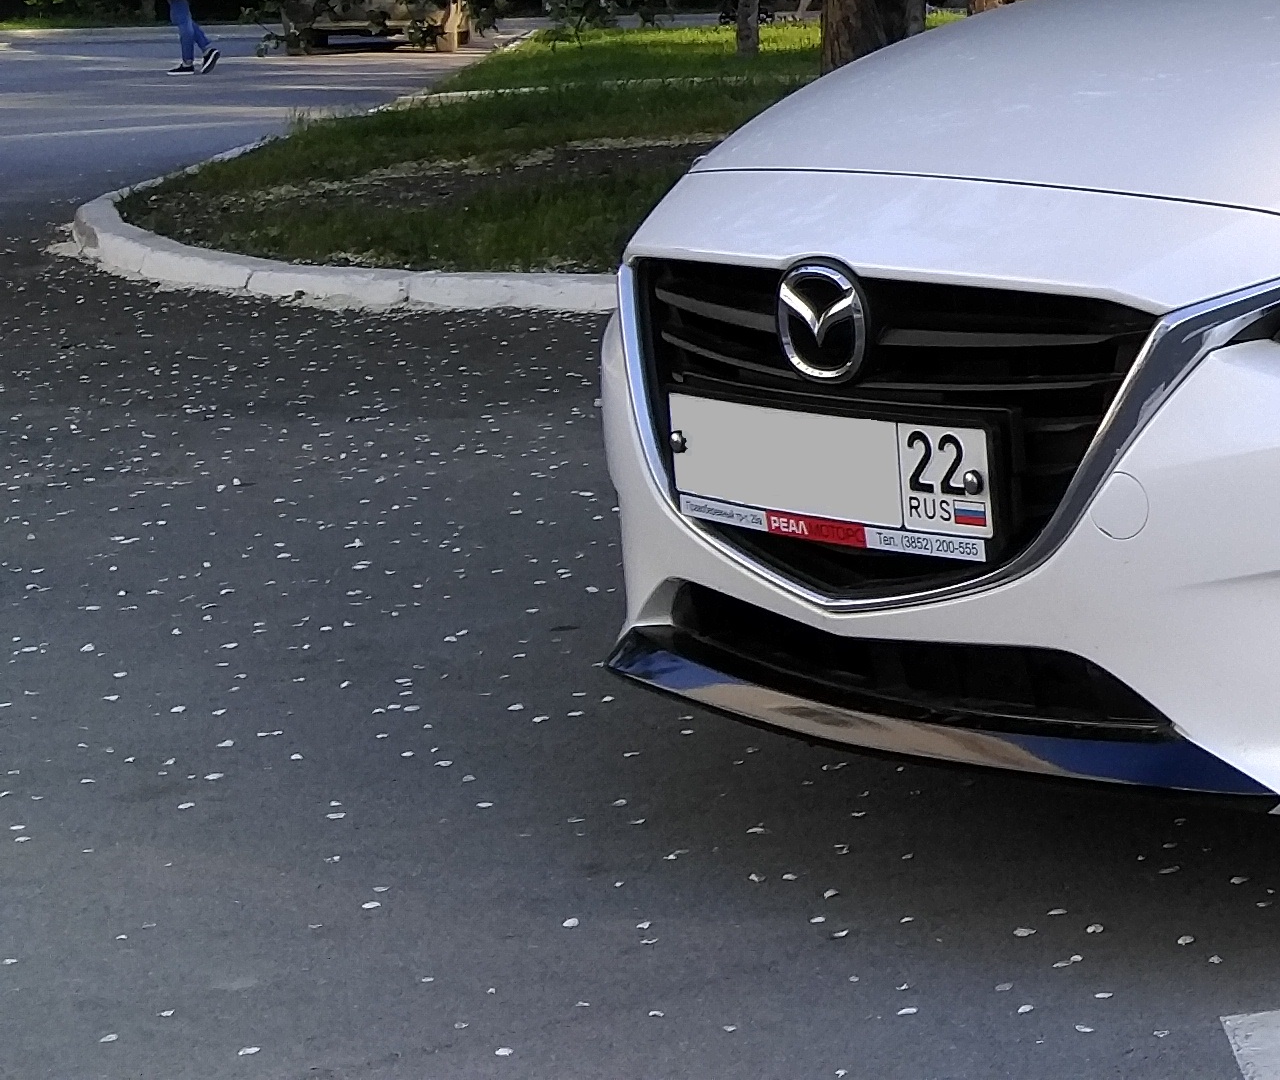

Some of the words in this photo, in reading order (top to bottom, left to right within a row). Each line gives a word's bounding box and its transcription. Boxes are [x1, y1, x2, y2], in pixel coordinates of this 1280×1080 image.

[906, 430, 967, 495] 22
[908, 496, 952, 522] RUS
[876, 532, 898, 548] Тел.
[901, 534, 933, 554] (3852)
[935, 539, 979, 556] 200-555
